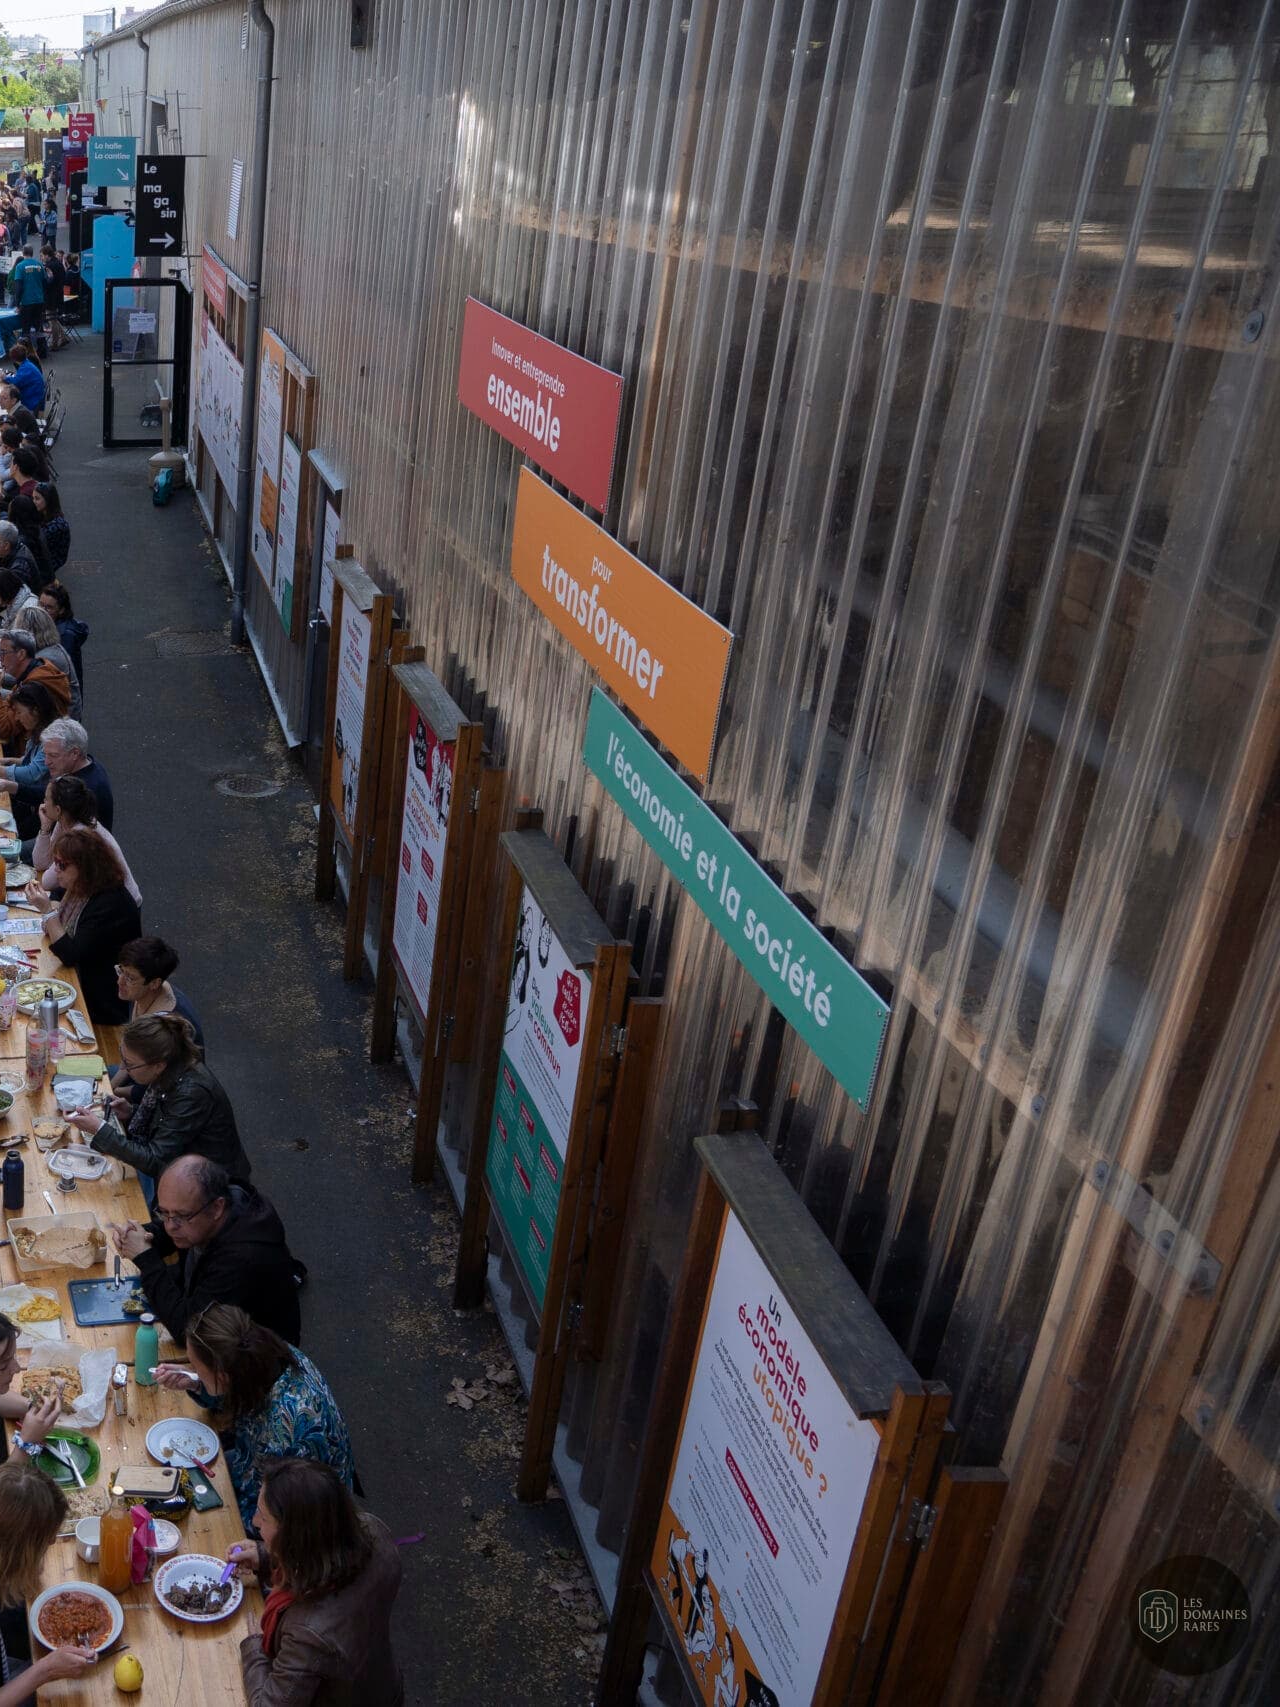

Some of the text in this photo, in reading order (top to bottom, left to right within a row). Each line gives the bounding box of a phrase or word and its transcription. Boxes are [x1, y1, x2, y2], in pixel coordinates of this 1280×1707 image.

[104, 152, 130, 160] cantine
[144, 163, 158, 174] Le
[143, 184, 162, 193] ma
[153, 196, 169, 209] ga
[160, 208, 177, 218] sin
[514, 355, 521, 370] et
[522, 358, 566, 398] entreprendre
[487, 373, 561, 452] ensemble
[591, 555, 613, 585] pour
[541, 543, 664, 700] transformer
[606, 731, 832, 1027] l'économie et la société
[531, 995, 555, 1047] valeurs
[533, 1020, 561, 1079] commun
[768, 1294, 782, 1328] Un
[756, 1303, 807, 1397] modèle
[738, 1302, 819, 1452] économique
[753, 1363, 815, 1479] utopique
[818, 1472, 828, 1499] ?
